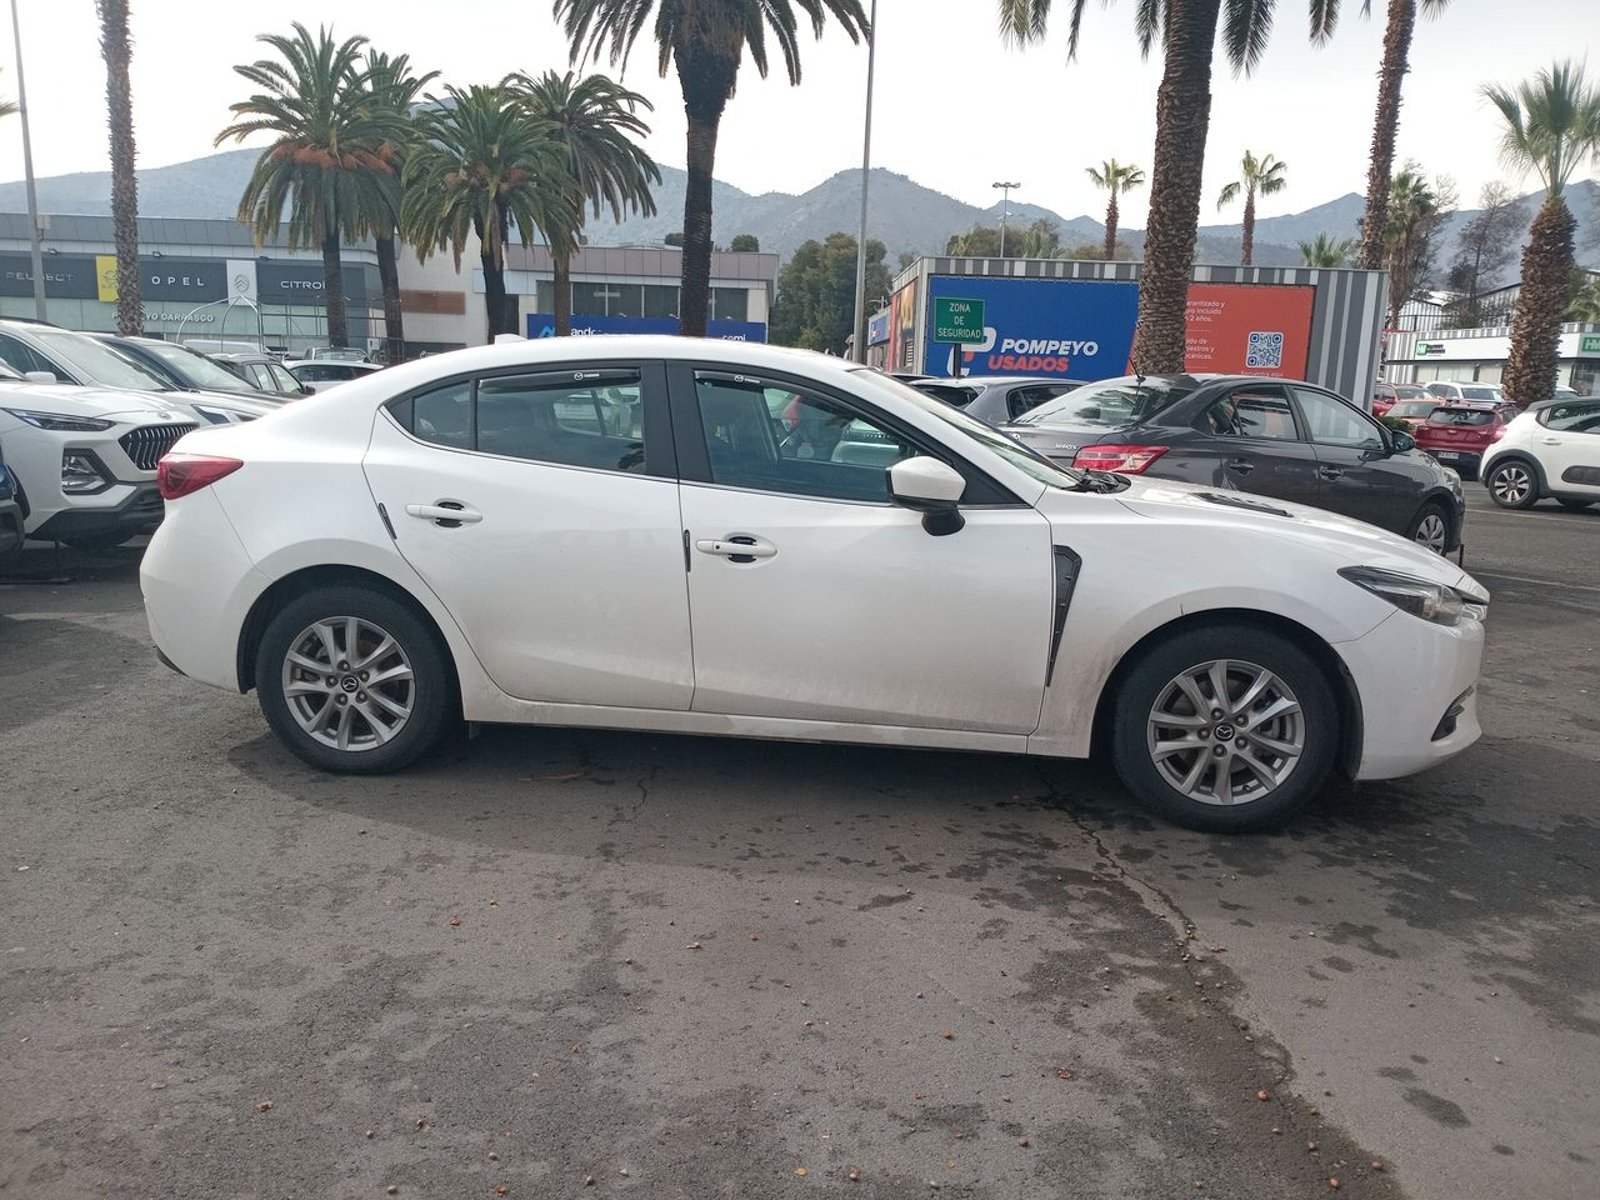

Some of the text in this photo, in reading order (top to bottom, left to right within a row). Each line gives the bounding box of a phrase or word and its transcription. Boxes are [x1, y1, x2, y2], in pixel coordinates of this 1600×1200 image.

[151, 275, 205, 287] OPEL
[949, 302, 971, 313] ZONA
[161, 312, 215, 323] CARRASCO
[954, 315, 965, 326] DE
[938, 327, 981, 339] SEGURIDAD
[1001, 339, 1099, 356] POMPEYO
[989, 355, 1069, 372] USADOS
